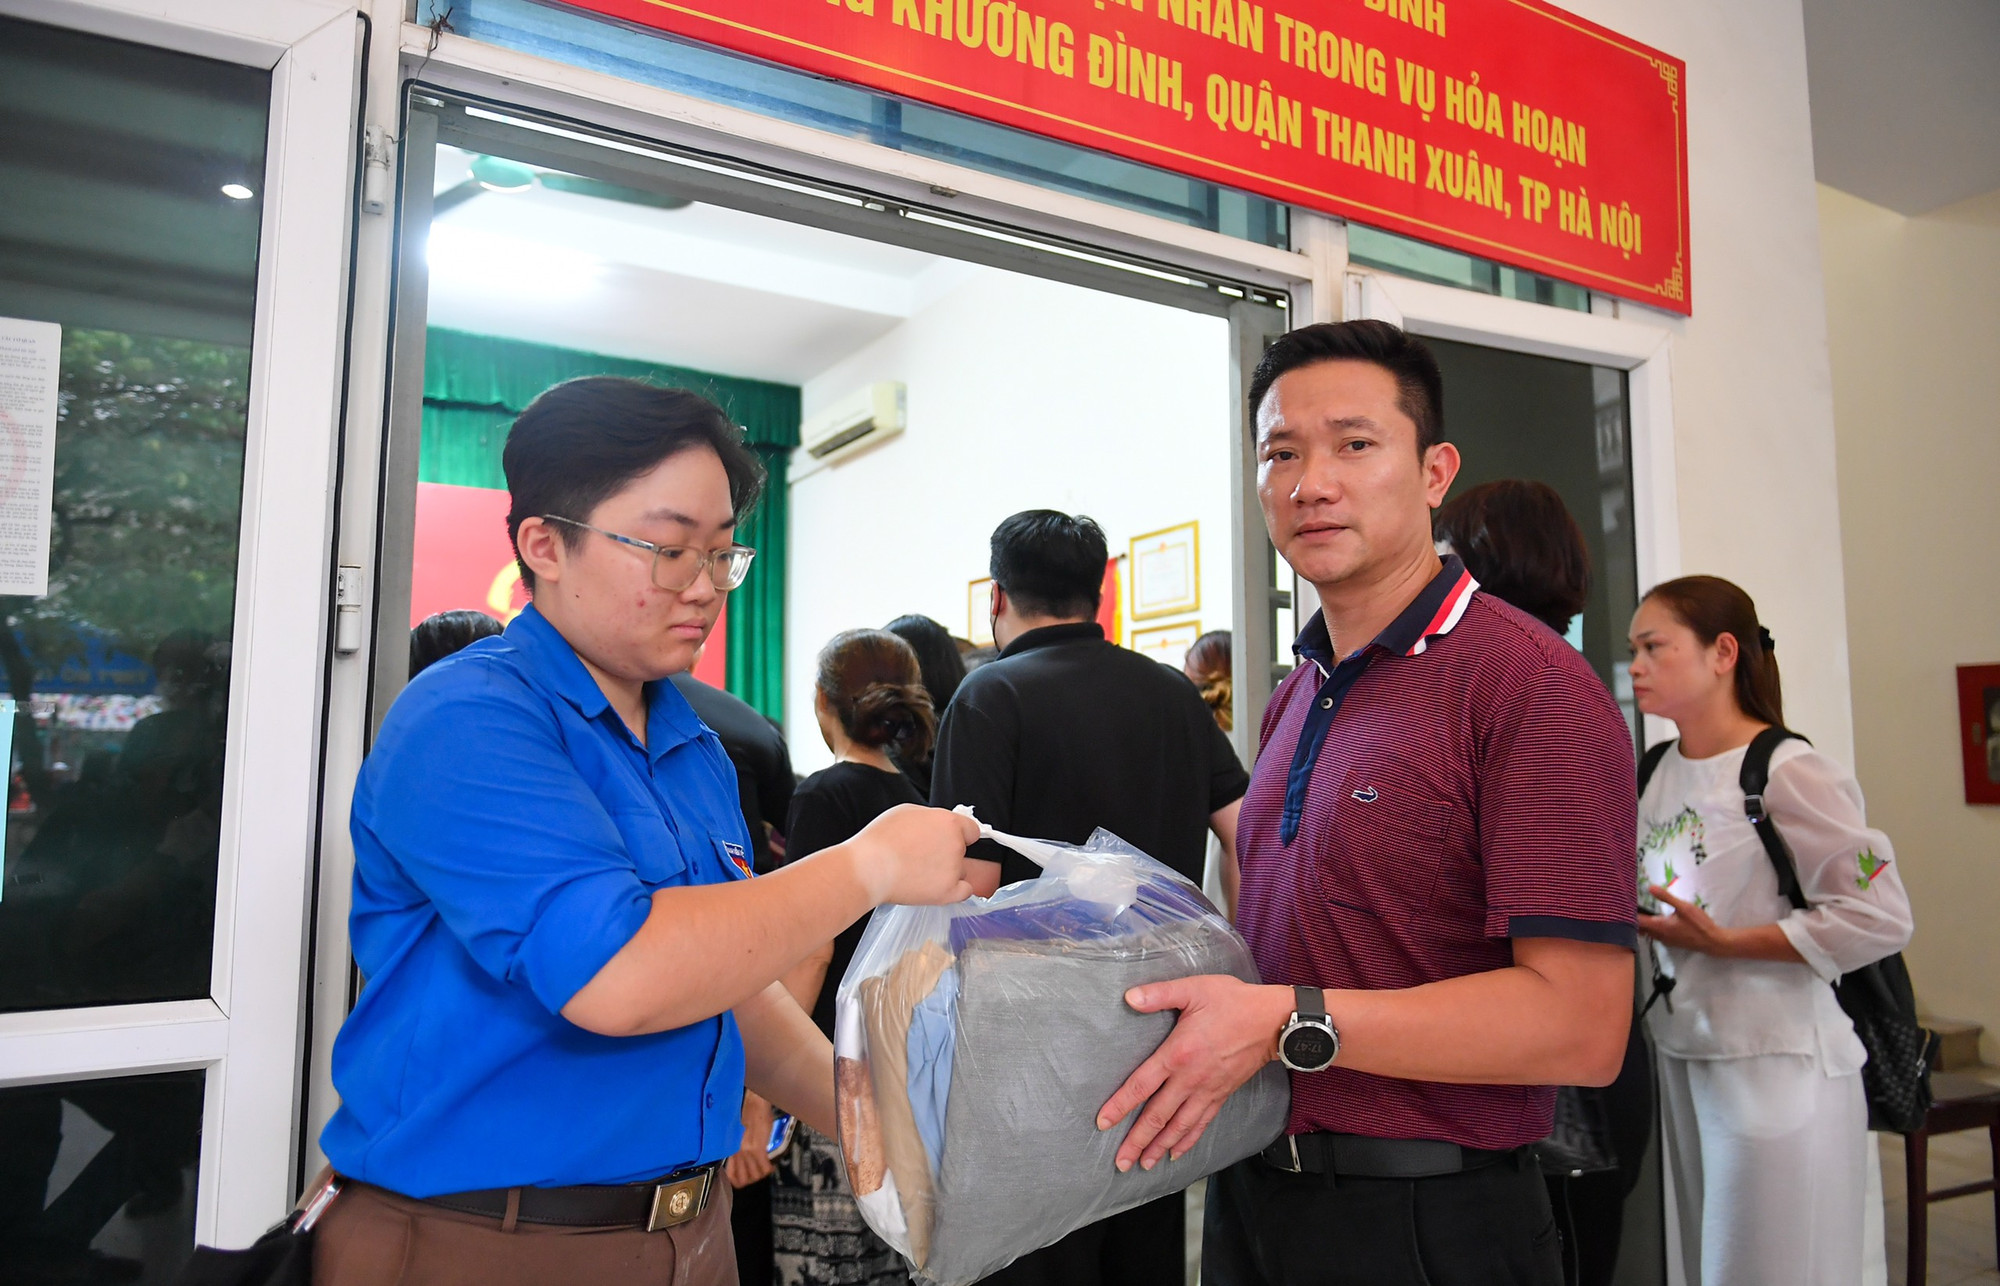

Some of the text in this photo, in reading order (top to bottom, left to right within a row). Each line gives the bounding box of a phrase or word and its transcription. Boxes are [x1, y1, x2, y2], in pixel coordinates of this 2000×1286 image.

[1364, 0, 1446, 38] NH
[1274, 12, 1386, 97] TRONG
[1395, 57, 1436, 122] VỤ
[1445, 71, 1505, 138] HỎA
[1512, 101, 1586, 168] HOẠN
[1087, 30, 1194, 121] ĐÌNH,
[1206, 74, 1302, 150] QUẬN
[1311, 106, 1416, 184] THANH
[1425, 144, 1512, 219] XUÂN,
[1519, 175, 1551, 223] TP
[1559, 185, 1594, 239] HÀ
[1600, 201, 1642, 259] NỘI
[1295, 1042, 1322, 1053] 17:47
